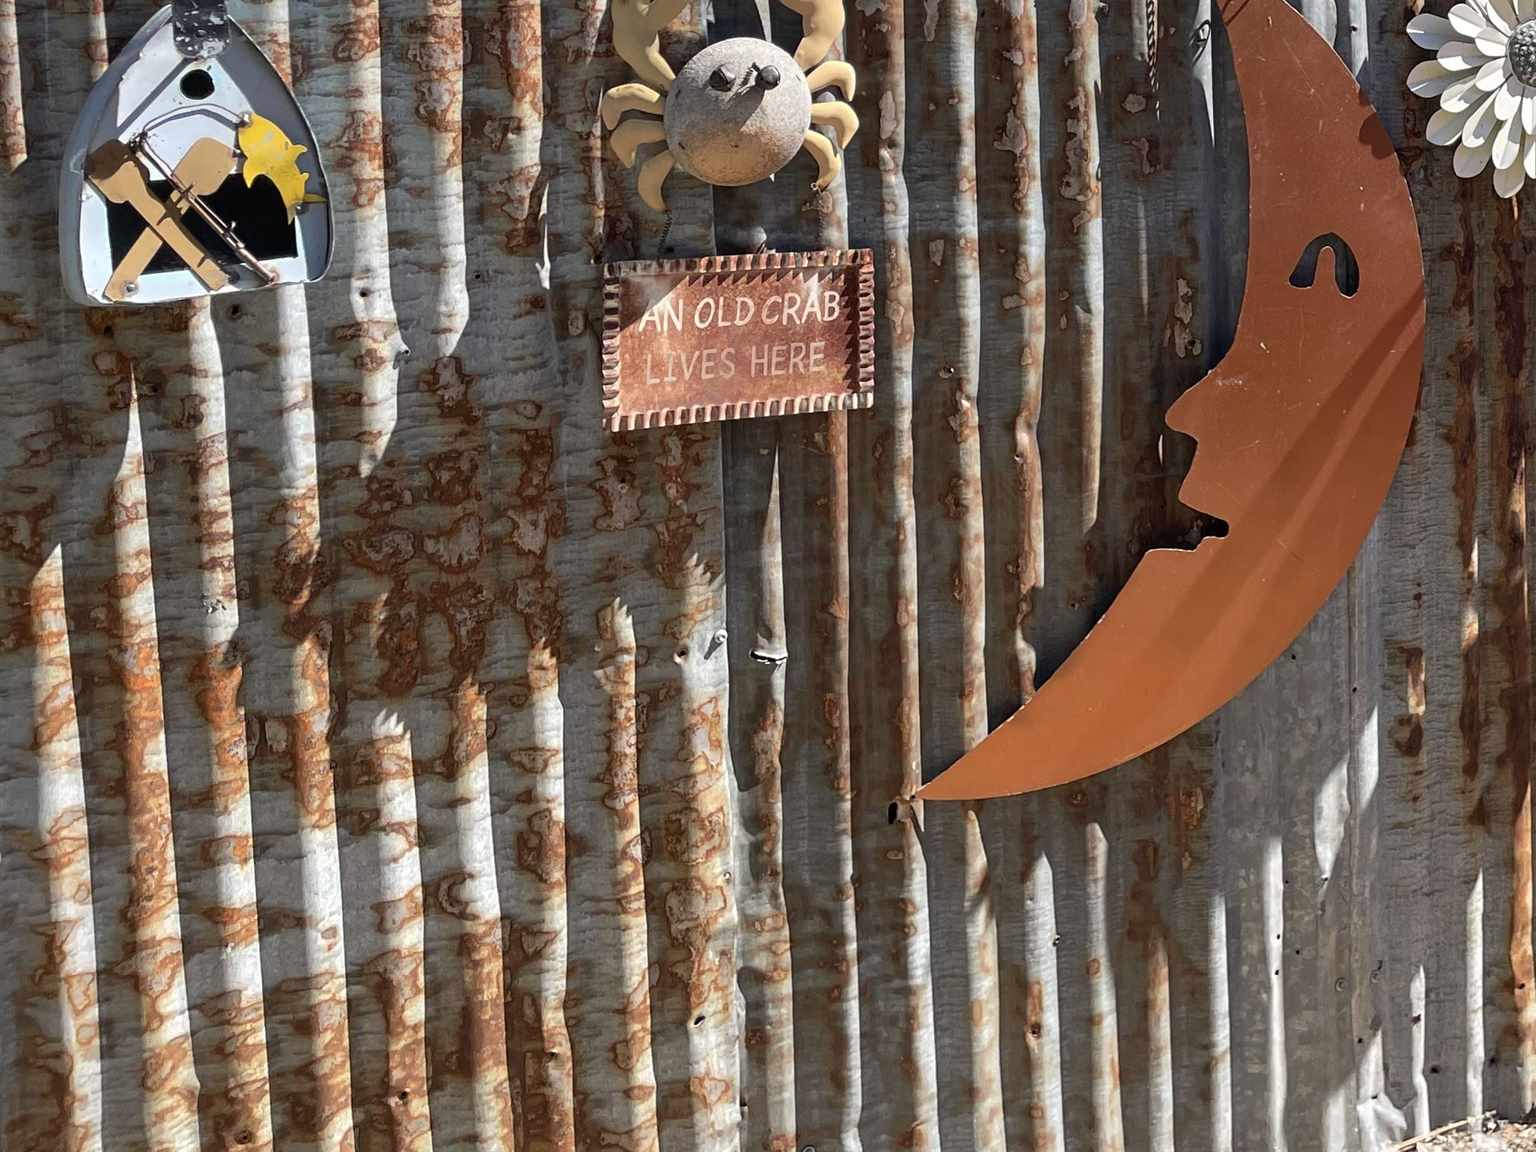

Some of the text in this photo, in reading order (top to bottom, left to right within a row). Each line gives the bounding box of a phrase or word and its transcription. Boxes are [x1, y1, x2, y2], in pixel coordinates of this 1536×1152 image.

[638, 291, 841, 336] AN OLD CRAB
[645, 341, 828, 385] LIVES HERE
